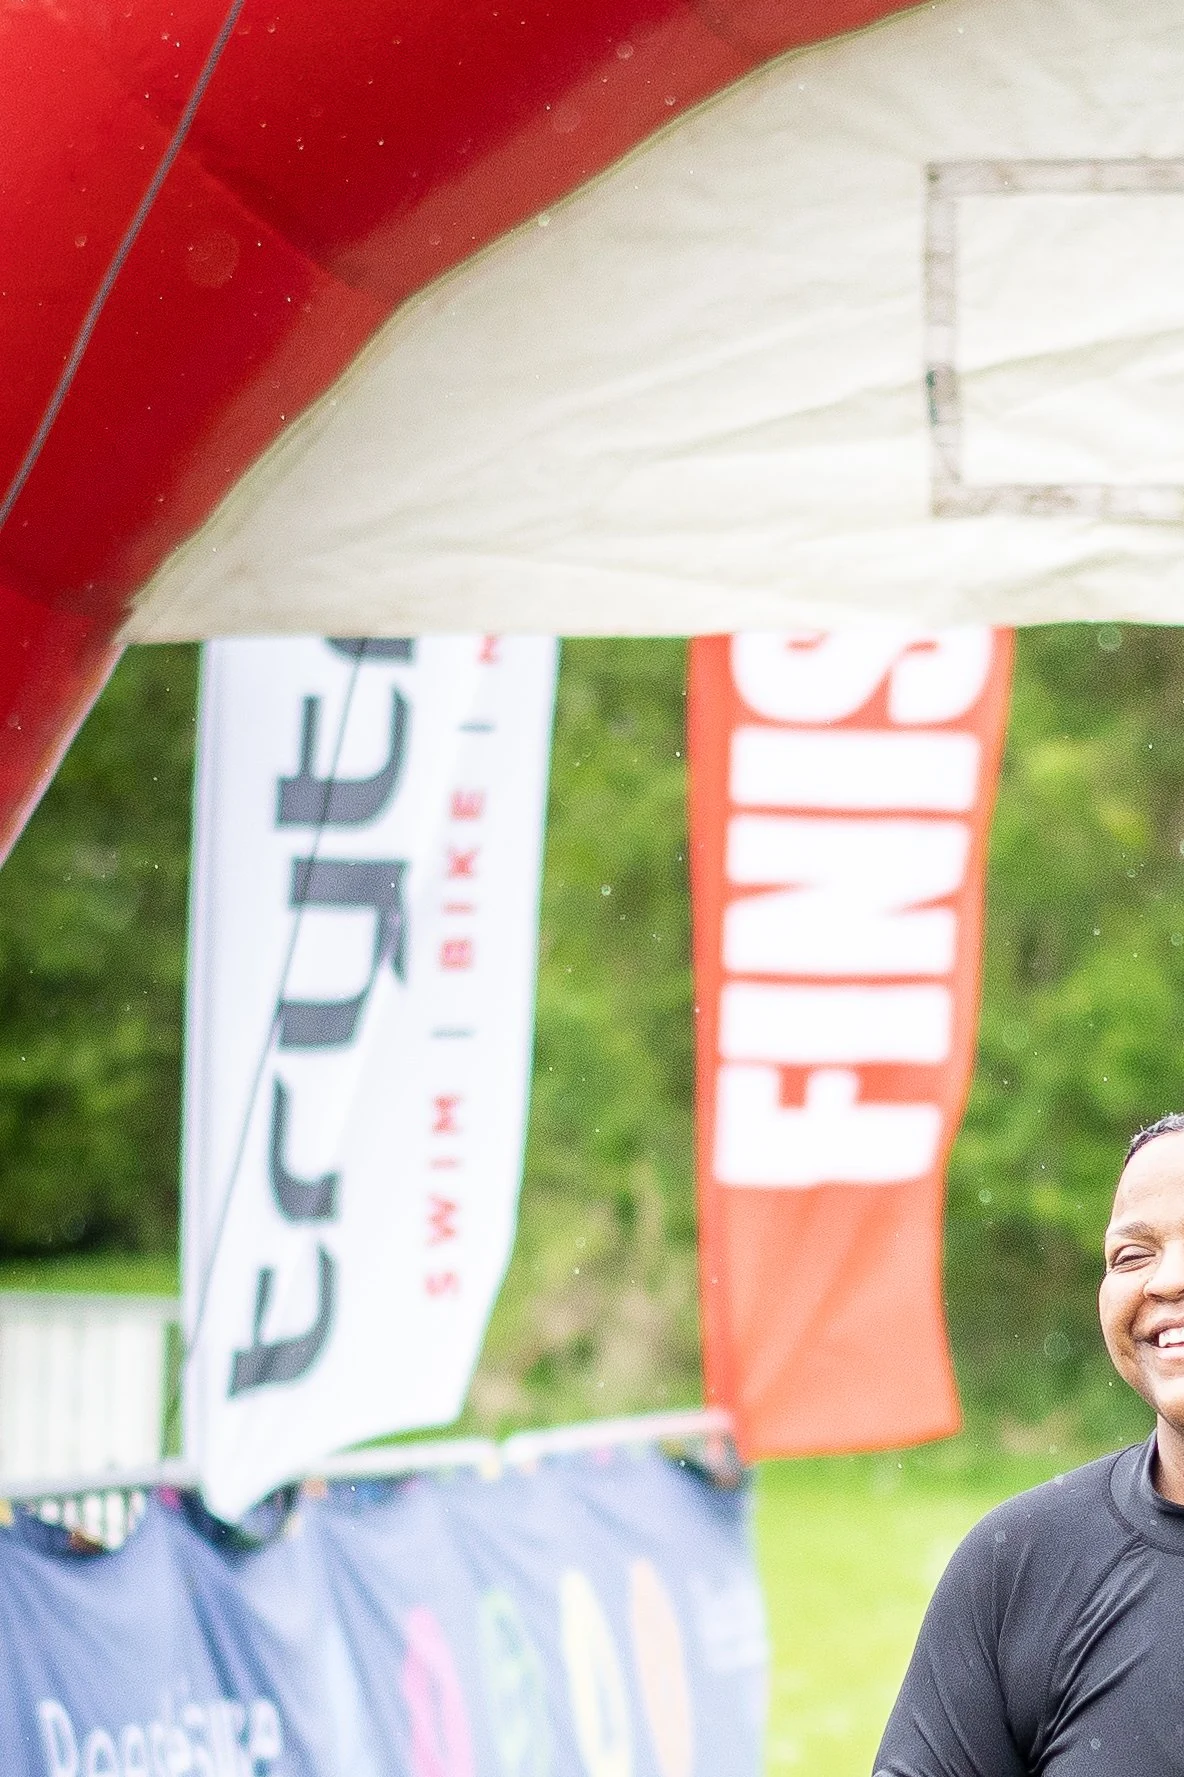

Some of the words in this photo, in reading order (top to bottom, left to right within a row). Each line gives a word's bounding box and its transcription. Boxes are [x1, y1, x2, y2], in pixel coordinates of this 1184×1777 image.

[438, 788, 487, 972] BIKE
[228, 637, 414, 1400] tryt
[425, 1093, 466, 1301] SWIM
